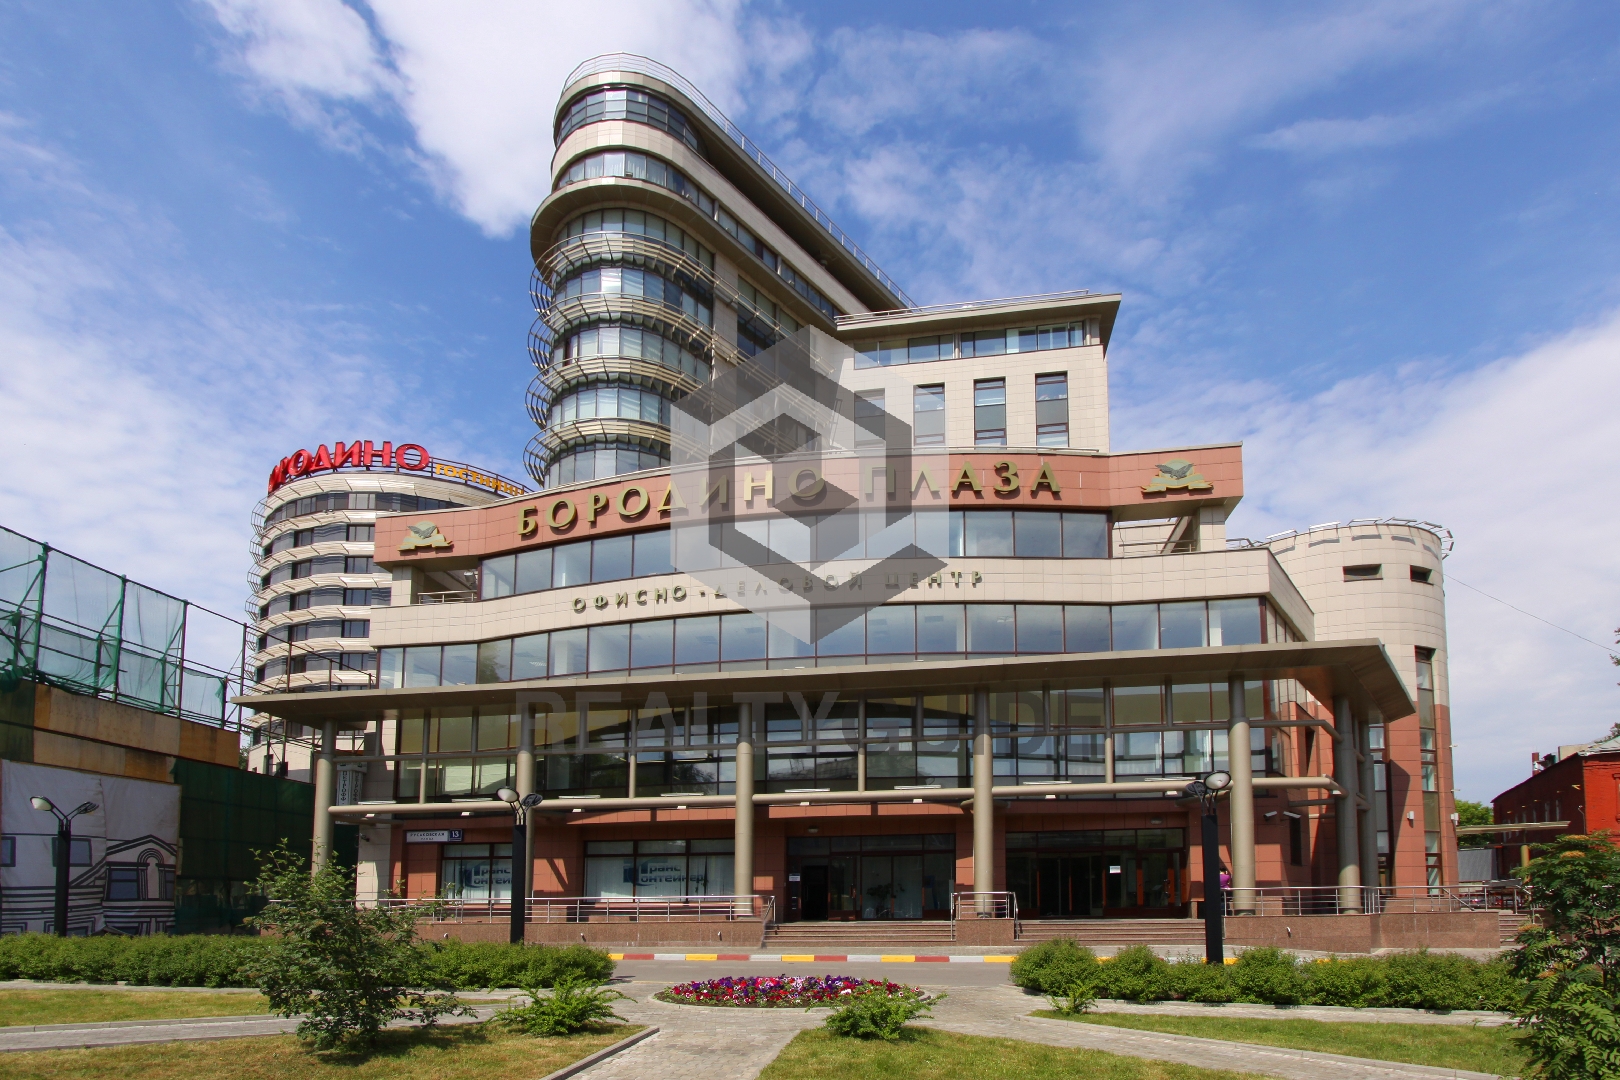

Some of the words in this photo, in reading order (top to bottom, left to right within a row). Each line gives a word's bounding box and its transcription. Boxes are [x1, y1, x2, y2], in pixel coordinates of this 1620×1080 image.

[434, 463, 525, 496] ГОСТИНИЦ
[517, 465, 826, 536] БОРОДИНО
[864, 460, 1061, 493] ПЛАЗА
[884, 570, 982, 588] ЦЕНТР
[451, 830, 460, 838] 13
